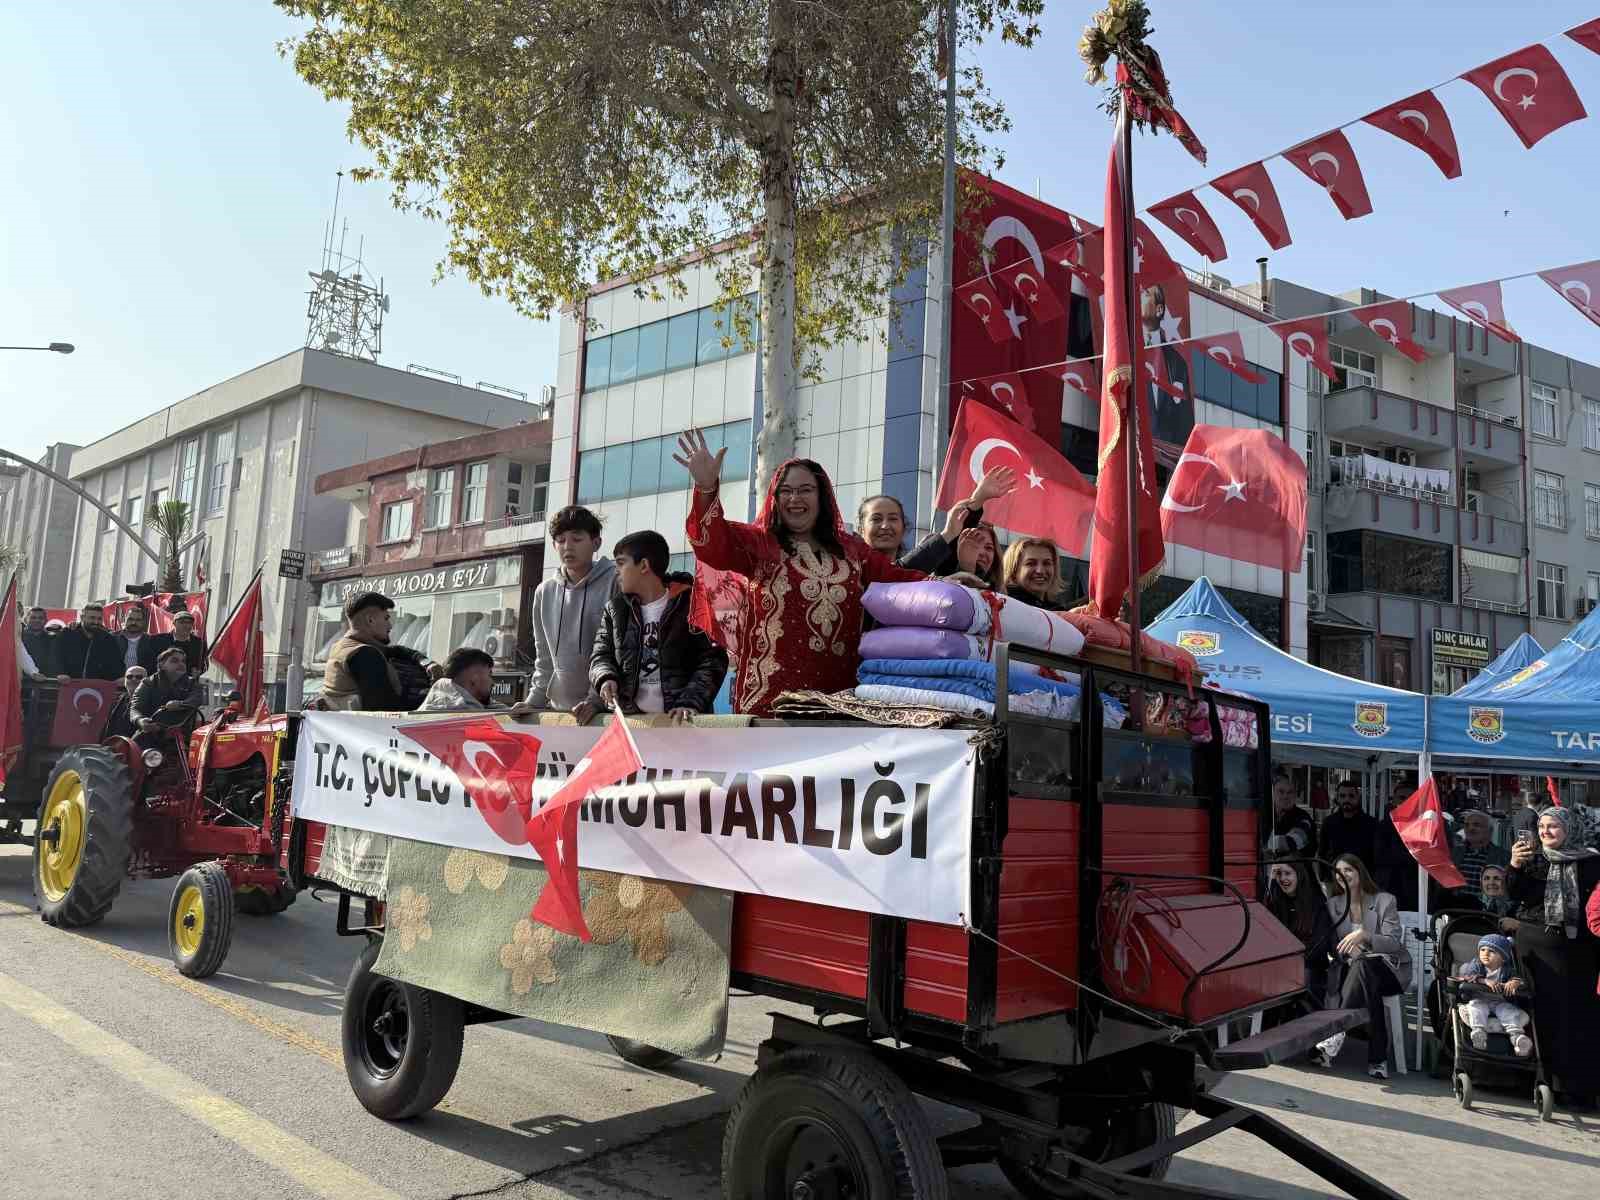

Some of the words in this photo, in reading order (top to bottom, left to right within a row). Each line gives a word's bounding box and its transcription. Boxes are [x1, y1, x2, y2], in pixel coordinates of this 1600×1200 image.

[392, 571, 446, 597] MODA
[453, 563, 489, 588] EVİ
[1459, 635, 1487, 649] EMLAK
[314, 742, 353, 791] T.C.
